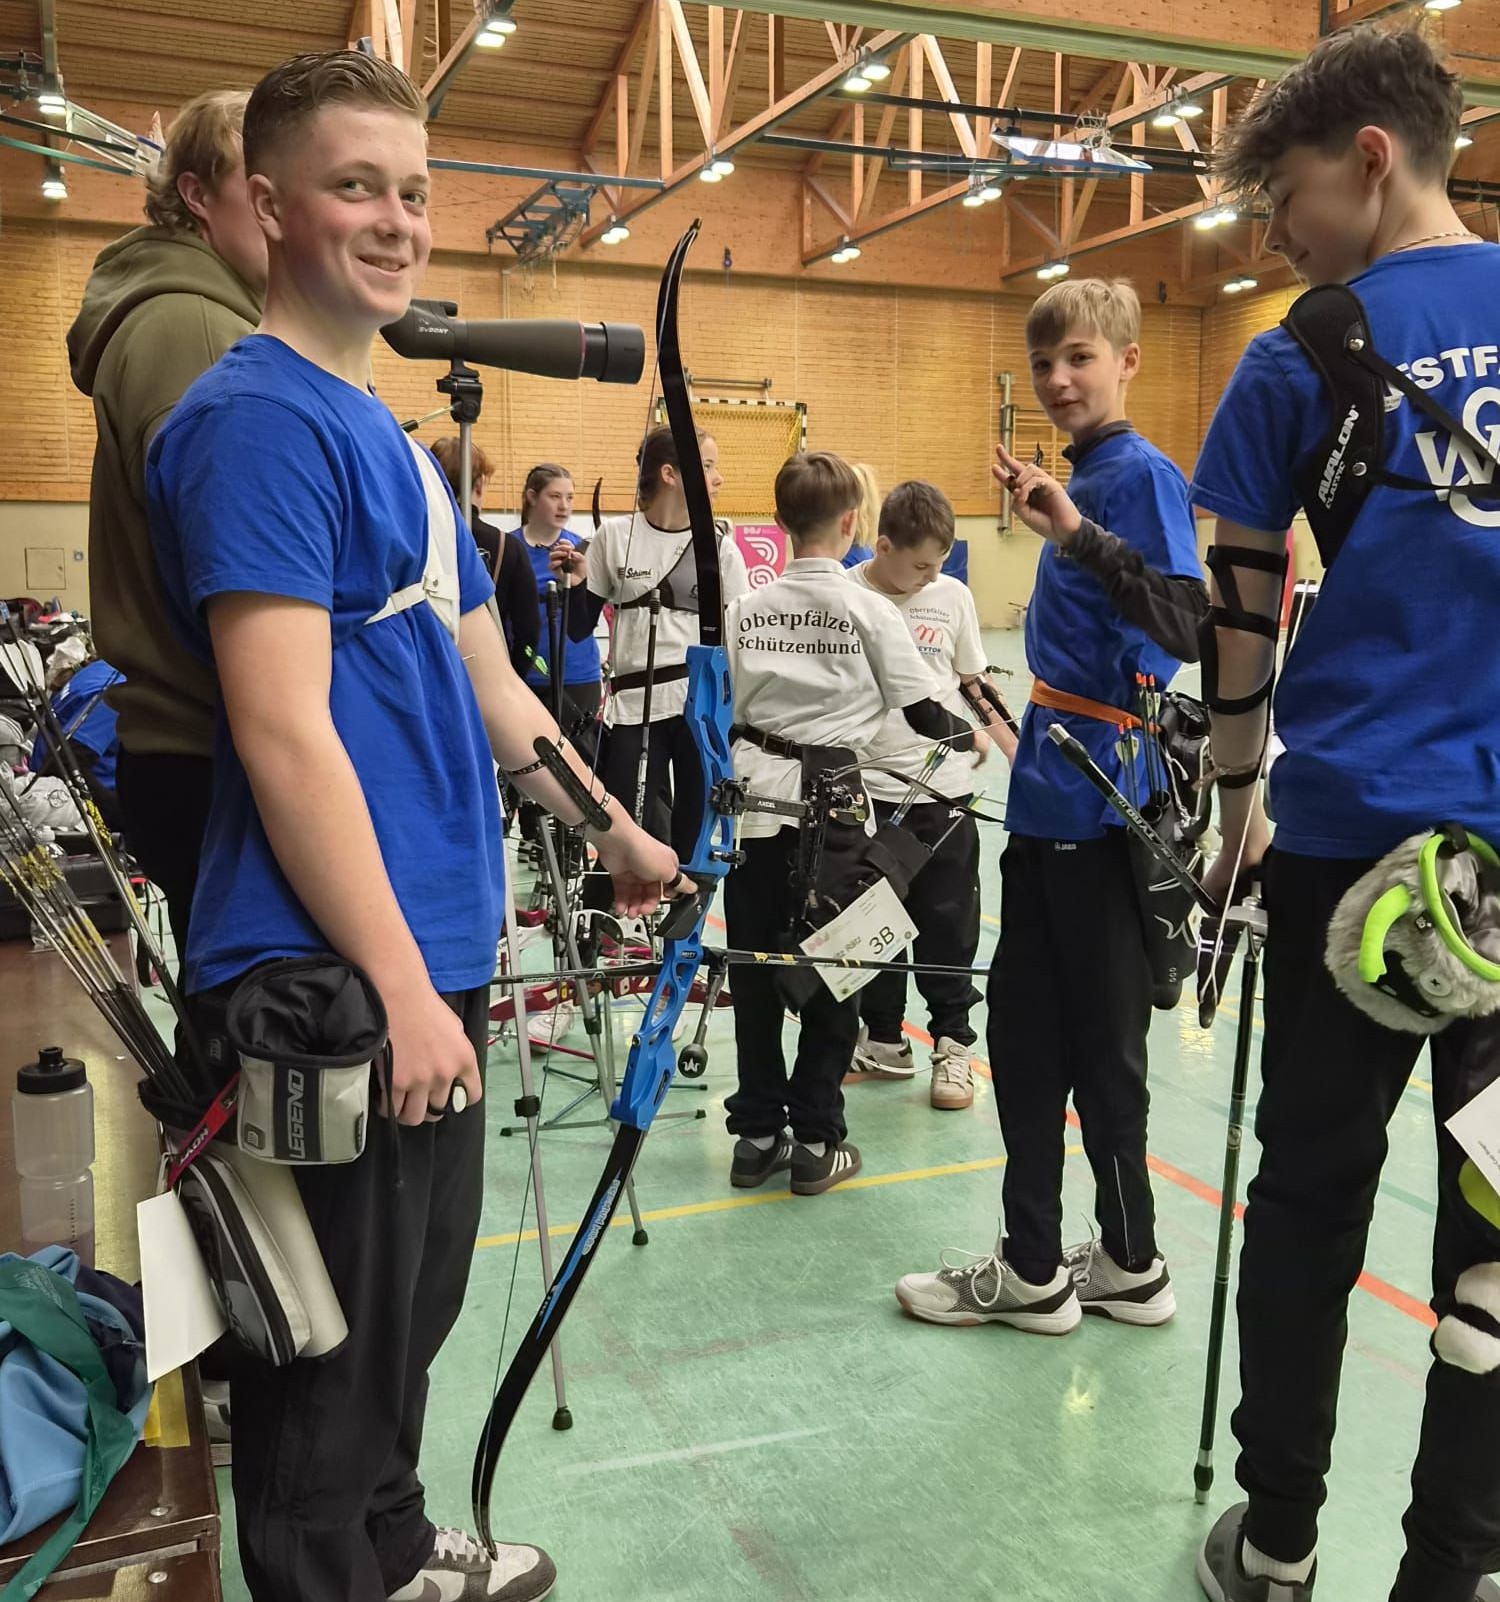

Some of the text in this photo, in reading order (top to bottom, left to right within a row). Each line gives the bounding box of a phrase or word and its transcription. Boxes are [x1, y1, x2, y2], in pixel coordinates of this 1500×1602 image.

[1318, 409, 1359, 503] AVALON
[1325, 460, 1346, 509] CLASSIC
[737, 636, 861, 655] Schützenbund
[869, 926, 895, 955] 3B
[287, 1068, 305, 1160] LEGEND
